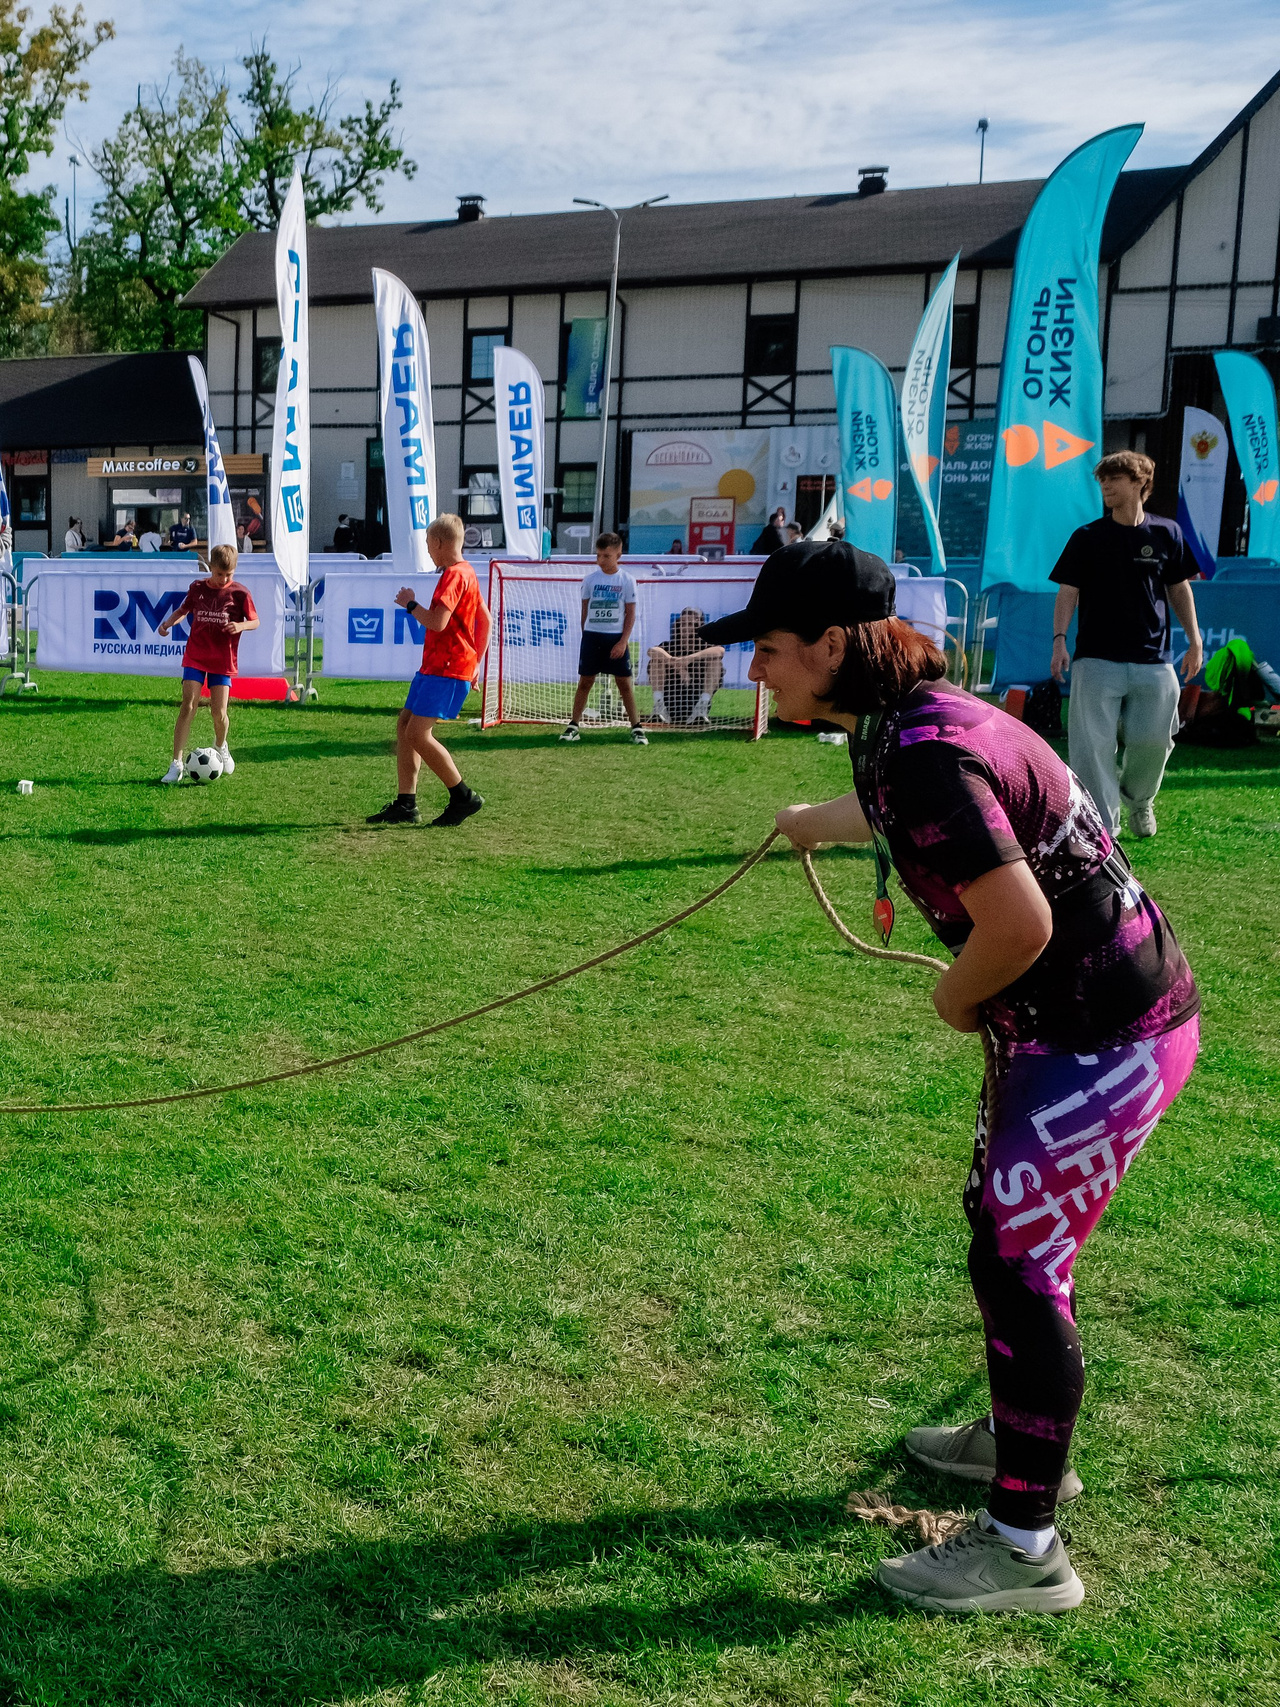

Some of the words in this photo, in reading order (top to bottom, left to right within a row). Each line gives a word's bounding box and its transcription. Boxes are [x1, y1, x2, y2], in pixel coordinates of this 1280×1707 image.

[1023, 286, 1052, 400] ОГОНЬ
[1049, 277, 1078, 408] ЖИЗНИ
[137, 458, 181, 471] coffee
[964, 443, 992, 451] ЖИЗ
[94, 590, 192, 642] RM
[595, 610, 612, 618] 556
[93, 643, 140, 655] РУССКАЯ
[1026, 1090, 1118, 1214] LIFE
[992, 1160, 1078, 1298] STYL
